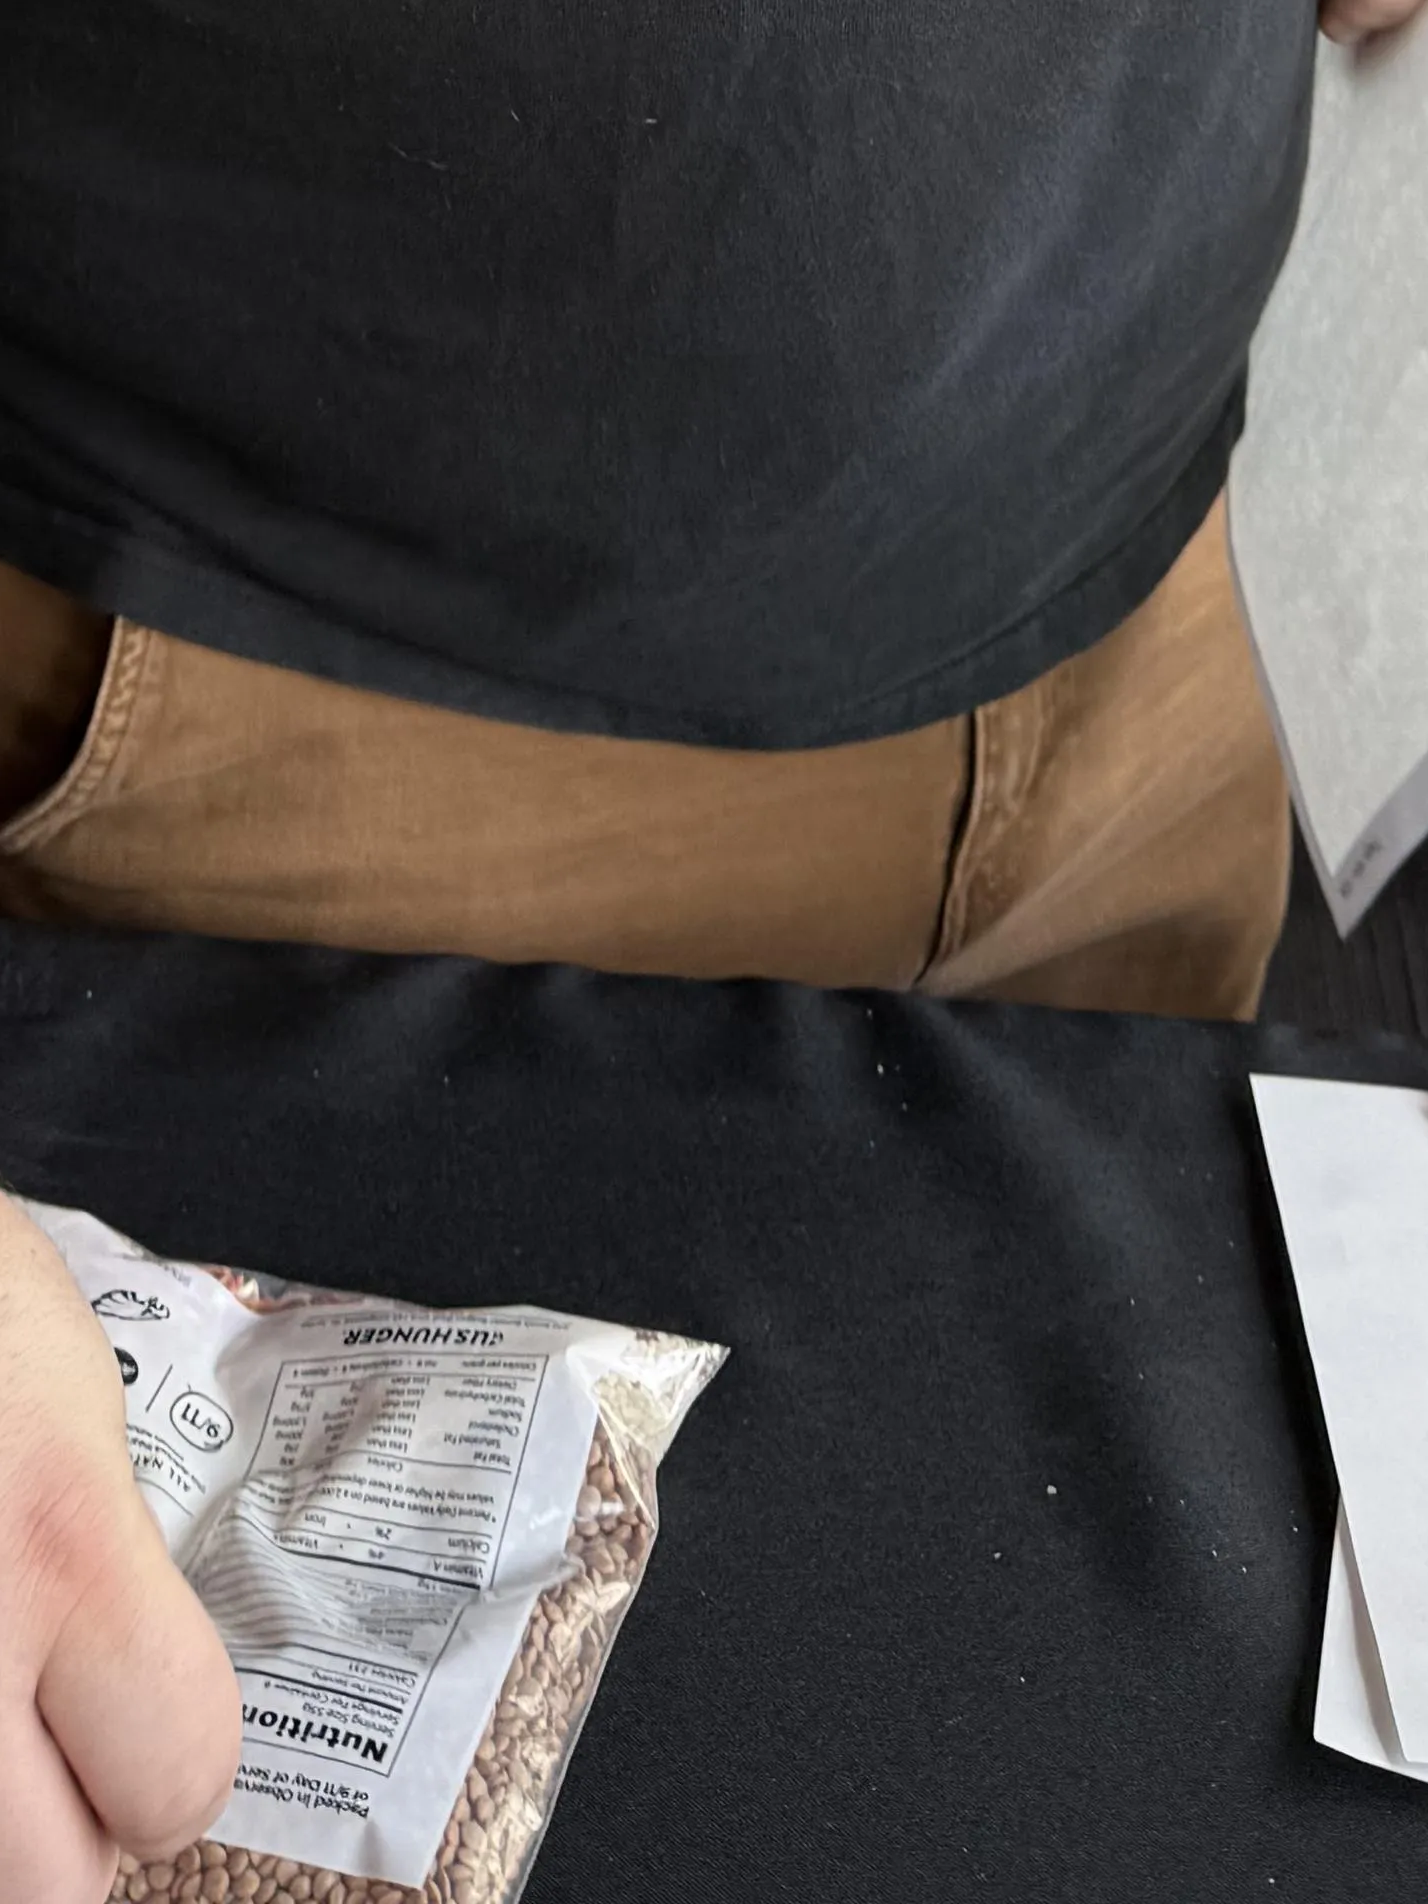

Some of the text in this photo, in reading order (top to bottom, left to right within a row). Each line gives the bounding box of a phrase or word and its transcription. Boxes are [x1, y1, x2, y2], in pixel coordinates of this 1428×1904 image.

[343, 1327, 453, 1346] HUNGER
[180, 1403, 221, 1439] 9/11
[473, 1452, 488, 1464] Fat
[489, 1454, 511, 1467] Total
[448, 1538, 490, 1553] Calcium
[242, 1703, 388, 1764] Nutrition
[352, 1714, 395, 1738] Serving
[273, 1771, 289, 1784] of
[292, 1772, 321, 1792] Day
[323, 1782, 351, 1799] 9/11
[353, 1790, 369, 1801] of
[314, 1793, 369, 1819] Packed
